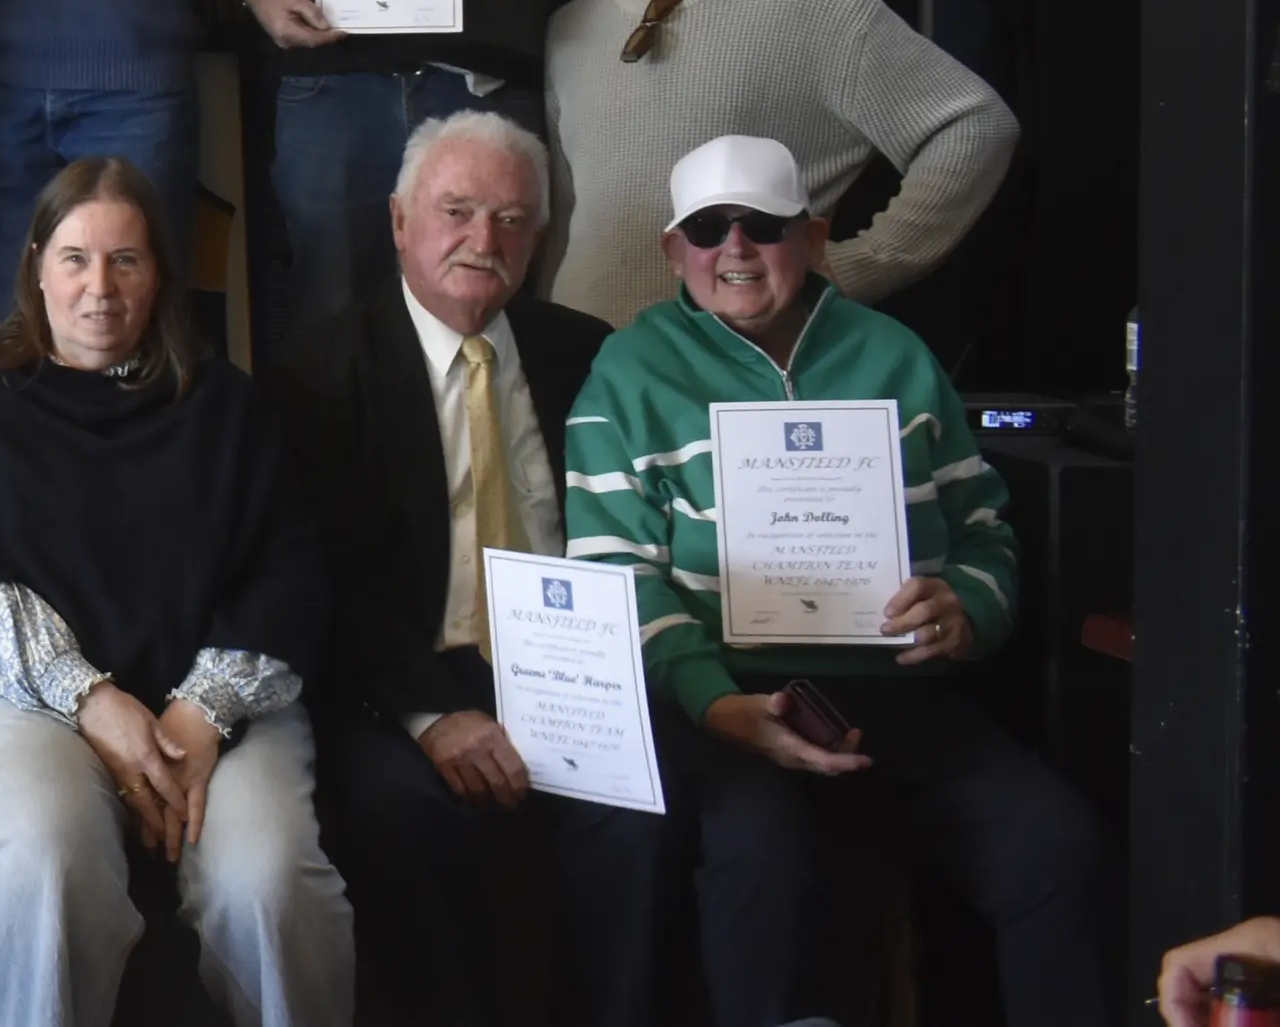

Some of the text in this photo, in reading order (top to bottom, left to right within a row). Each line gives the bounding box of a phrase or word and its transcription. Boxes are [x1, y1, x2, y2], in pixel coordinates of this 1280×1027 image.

[737, 455, 880, 471] MANSFIELD FC
[769, 511, 849, 525] John Dolling
[506, 608, 620, 636] MANSFIELD FC
[510, 662, 546, 679] Graeme
[583, 674, 622, 691] Harper
